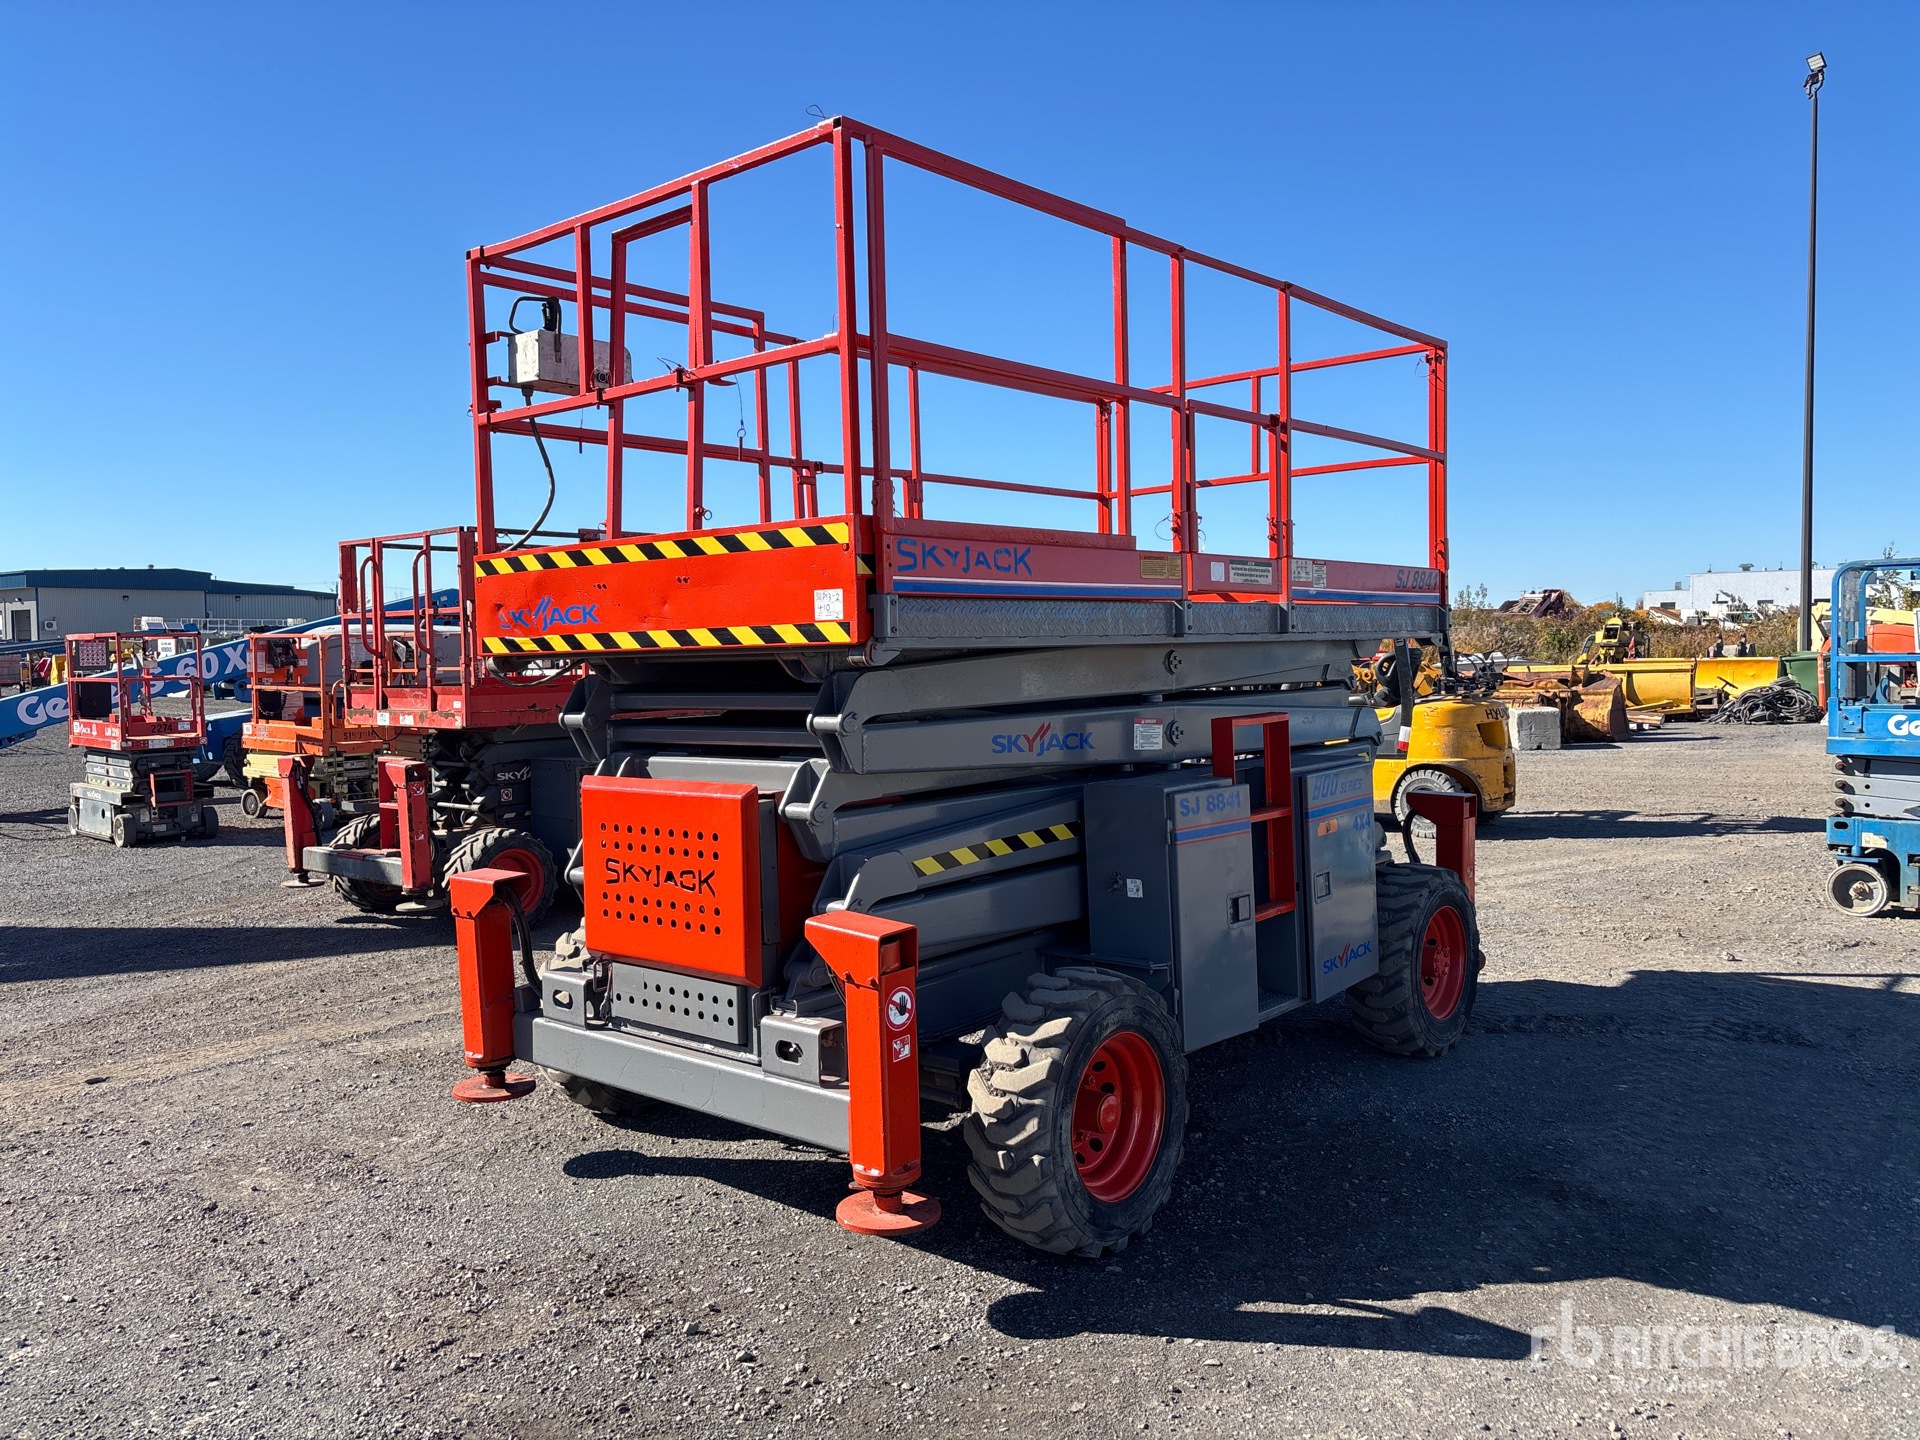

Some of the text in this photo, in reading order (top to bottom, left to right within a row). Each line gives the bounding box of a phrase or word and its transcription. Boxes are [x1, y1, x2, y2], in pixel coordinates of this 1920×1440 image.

[896, 537, 1033, 577] SKYJACK
[1395, 568, 1439, 591] SJ 8841
[150, 723, 174, 734] 2274
[991, 721, 1096, 757] SKYJACK
[1312, 771, 1363, 801] 800 SERIES
[1179, 790, 1242, 818] SJ 8841
[605, 857, 716, 899] SKYJACK
[1322, 940, 1373, 975] SKYJACK
